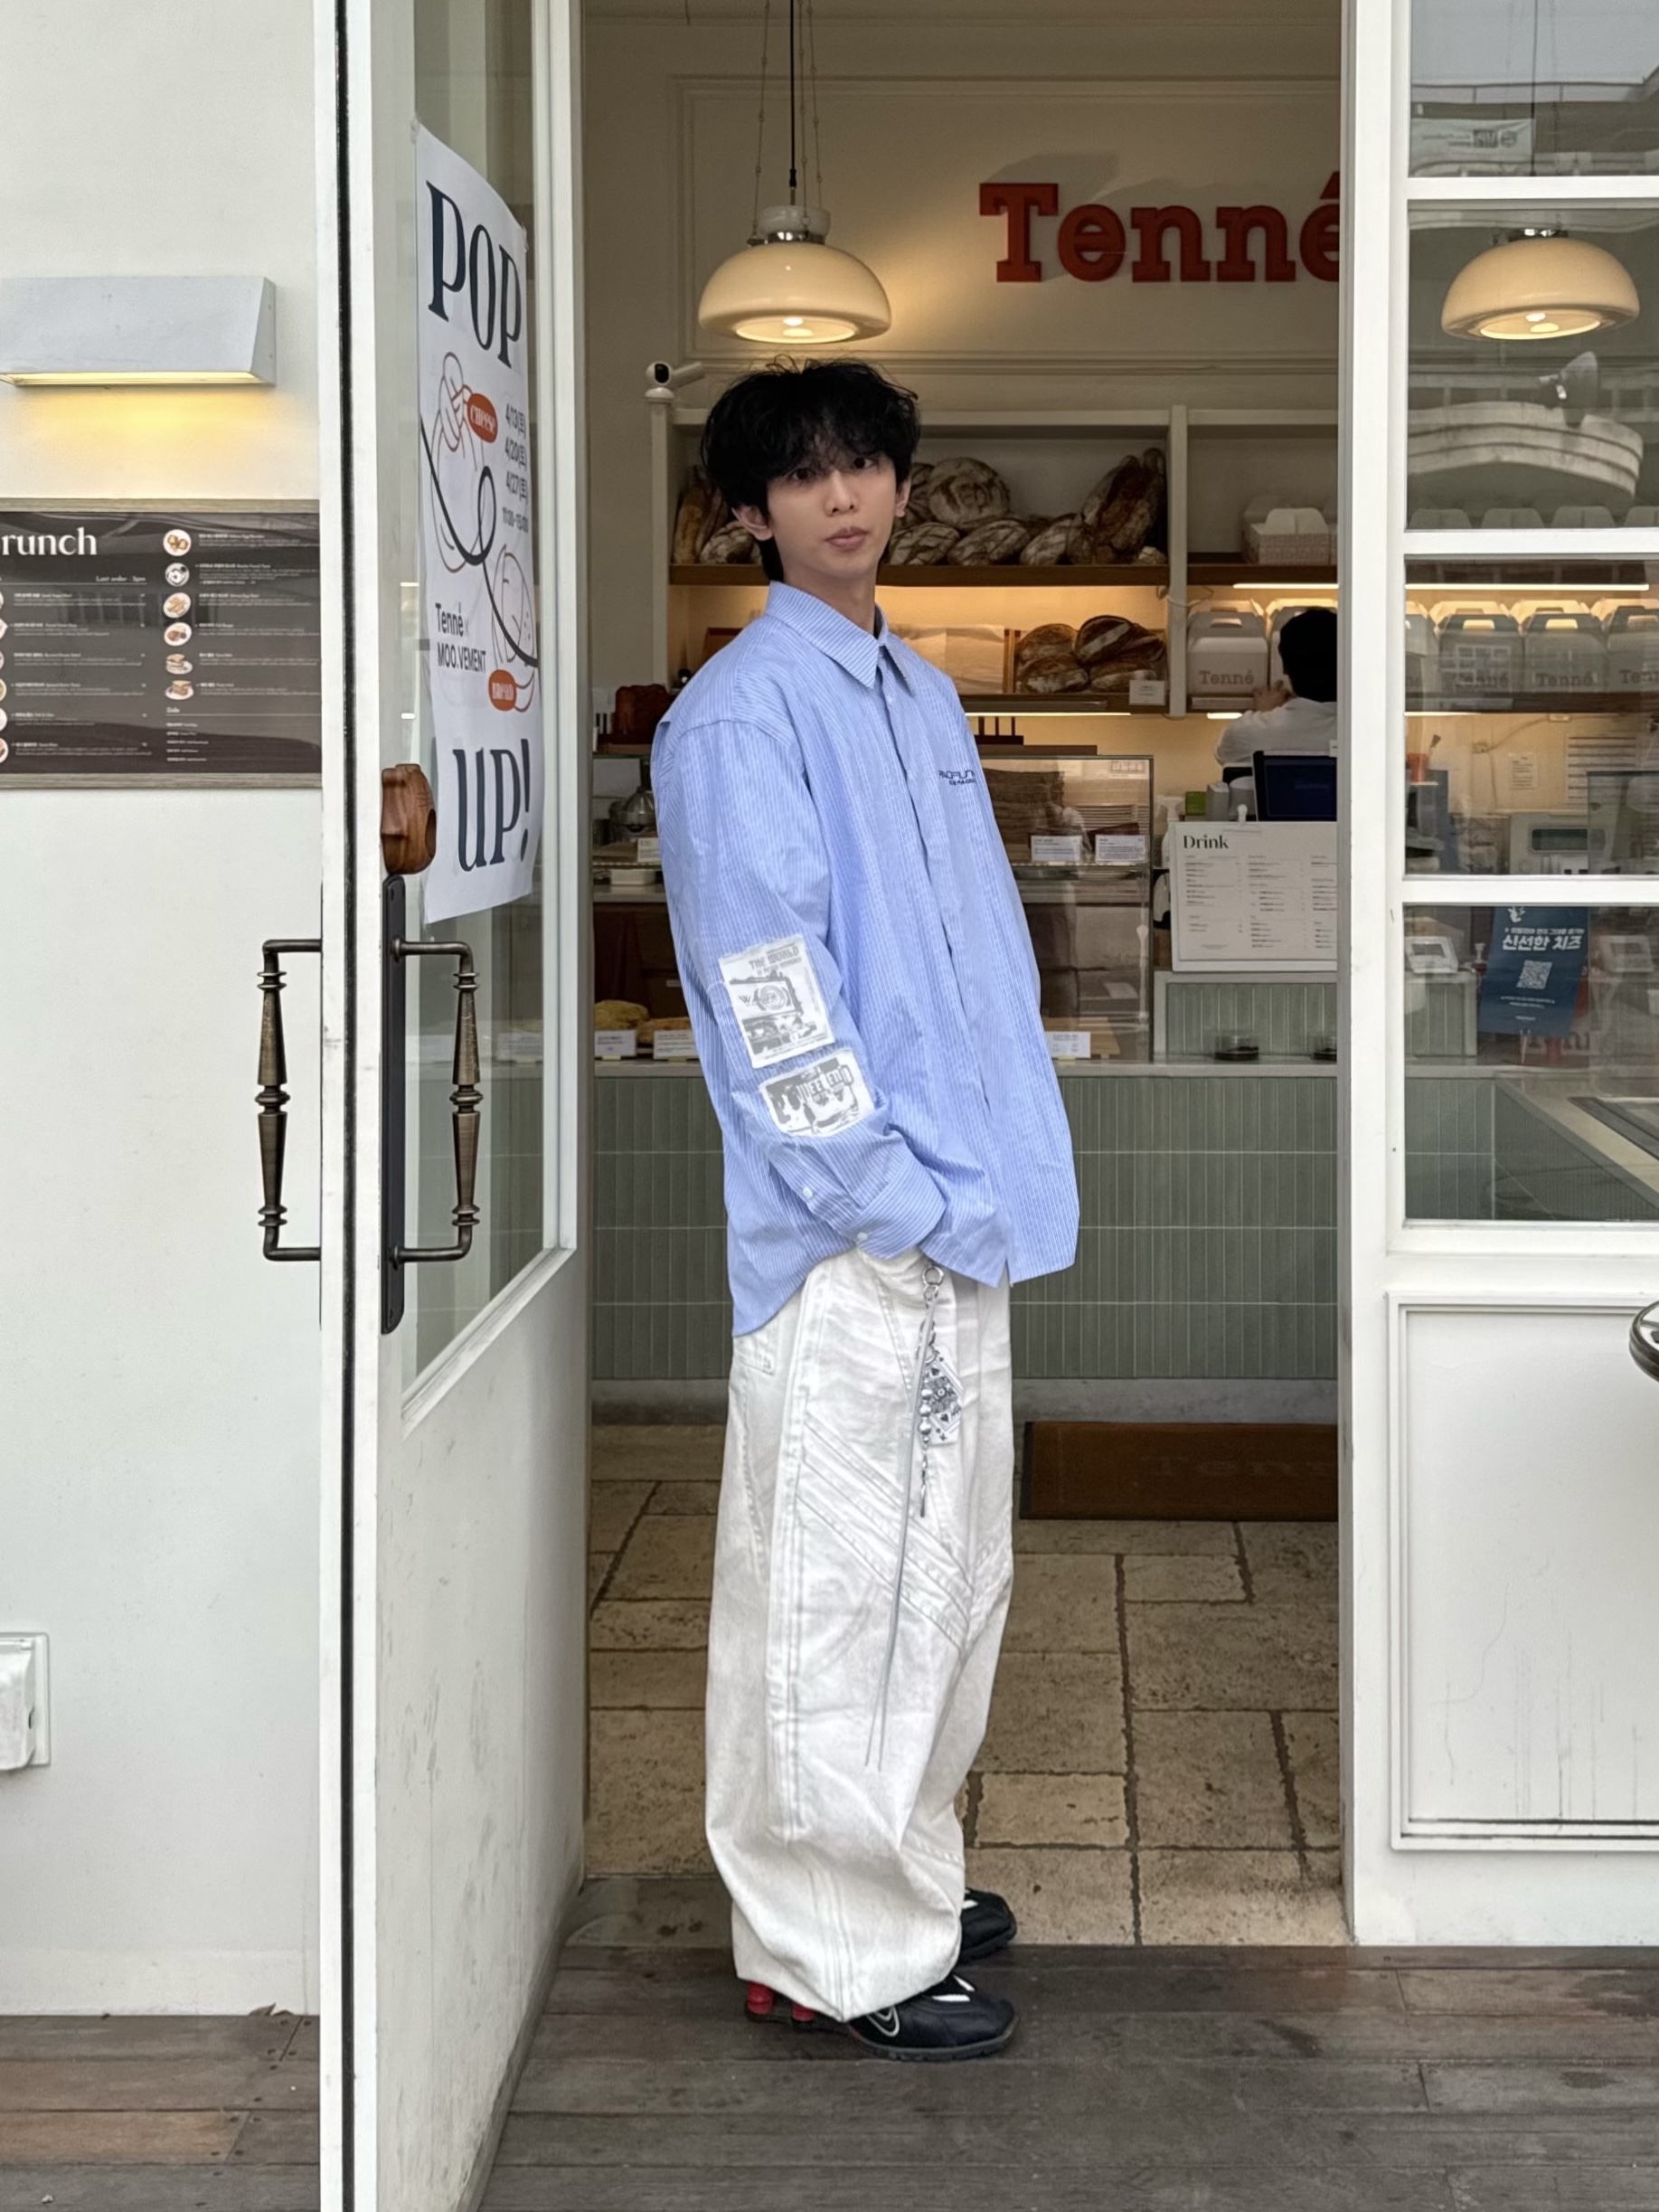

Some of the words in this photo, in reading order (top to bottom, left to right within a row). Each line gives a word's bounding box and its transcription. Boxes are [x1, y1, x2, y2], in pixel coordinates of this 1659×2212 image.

[426, 180, 522, 369] POP
[2, 526, 98, 555] runch
[435, 601, 464, 637] Tenné
[1199, 669, 1255, 685] Tenné
[452, 738, 531, 872] UP!
[1183, 835, 1230, 849] Drink
[1502, 934, 1551, 951] 신선한
[1552, 935, 1583, 950] 치즈
